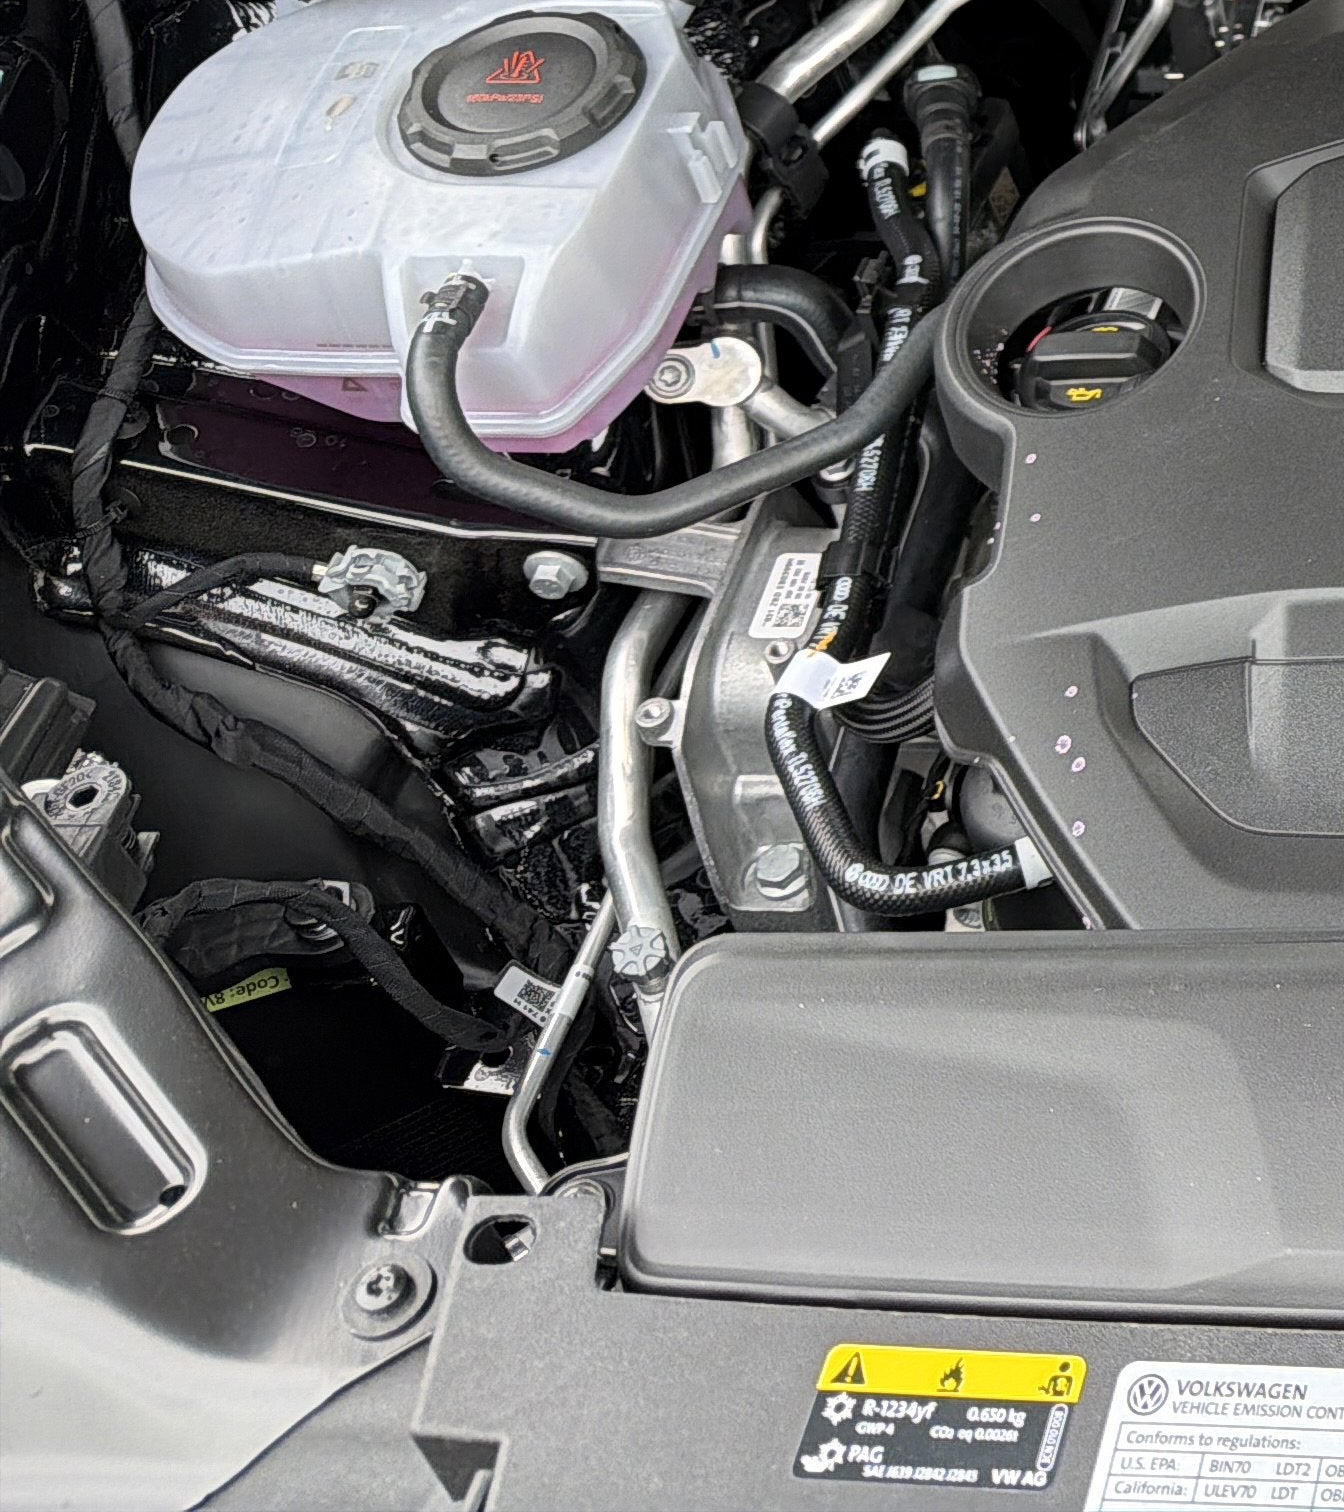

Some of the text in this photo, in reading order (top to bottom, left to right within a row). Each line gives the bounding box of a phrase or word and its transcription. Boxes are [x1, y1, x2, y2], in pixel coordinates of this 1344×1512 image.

[230, 975, 280, 997] Code:
[1177, 1379, 1308, 1400] VOLKSWAGEN
[861, 1398, 938, 1424] R-1234yf
[1008, 1408, 1026, 1428] kg
[1172, 1401, 1228, 1416] VEHICLE
[1232, 1403, 1302, 1418] EMISSION
[1126, 1430, 1301, 1450] Conforms to regulations:
[848, 1444, 885, 1463] PAG
[862, 1464, 886, 1479] SAE
[1120, 1457, 1147, 1471] U.S.
[1209, 1459, 1251, 1474] BIN70
[1276, 1461, 1311, 1477] LDT2
[991, 1468, 1048, 1487] VW AG
[1114, 1480, 1187, 1497] California:
[1204, 1483, 1257, 1500] ULEV70
[1271, 1485, 1299, 1500] LDT
